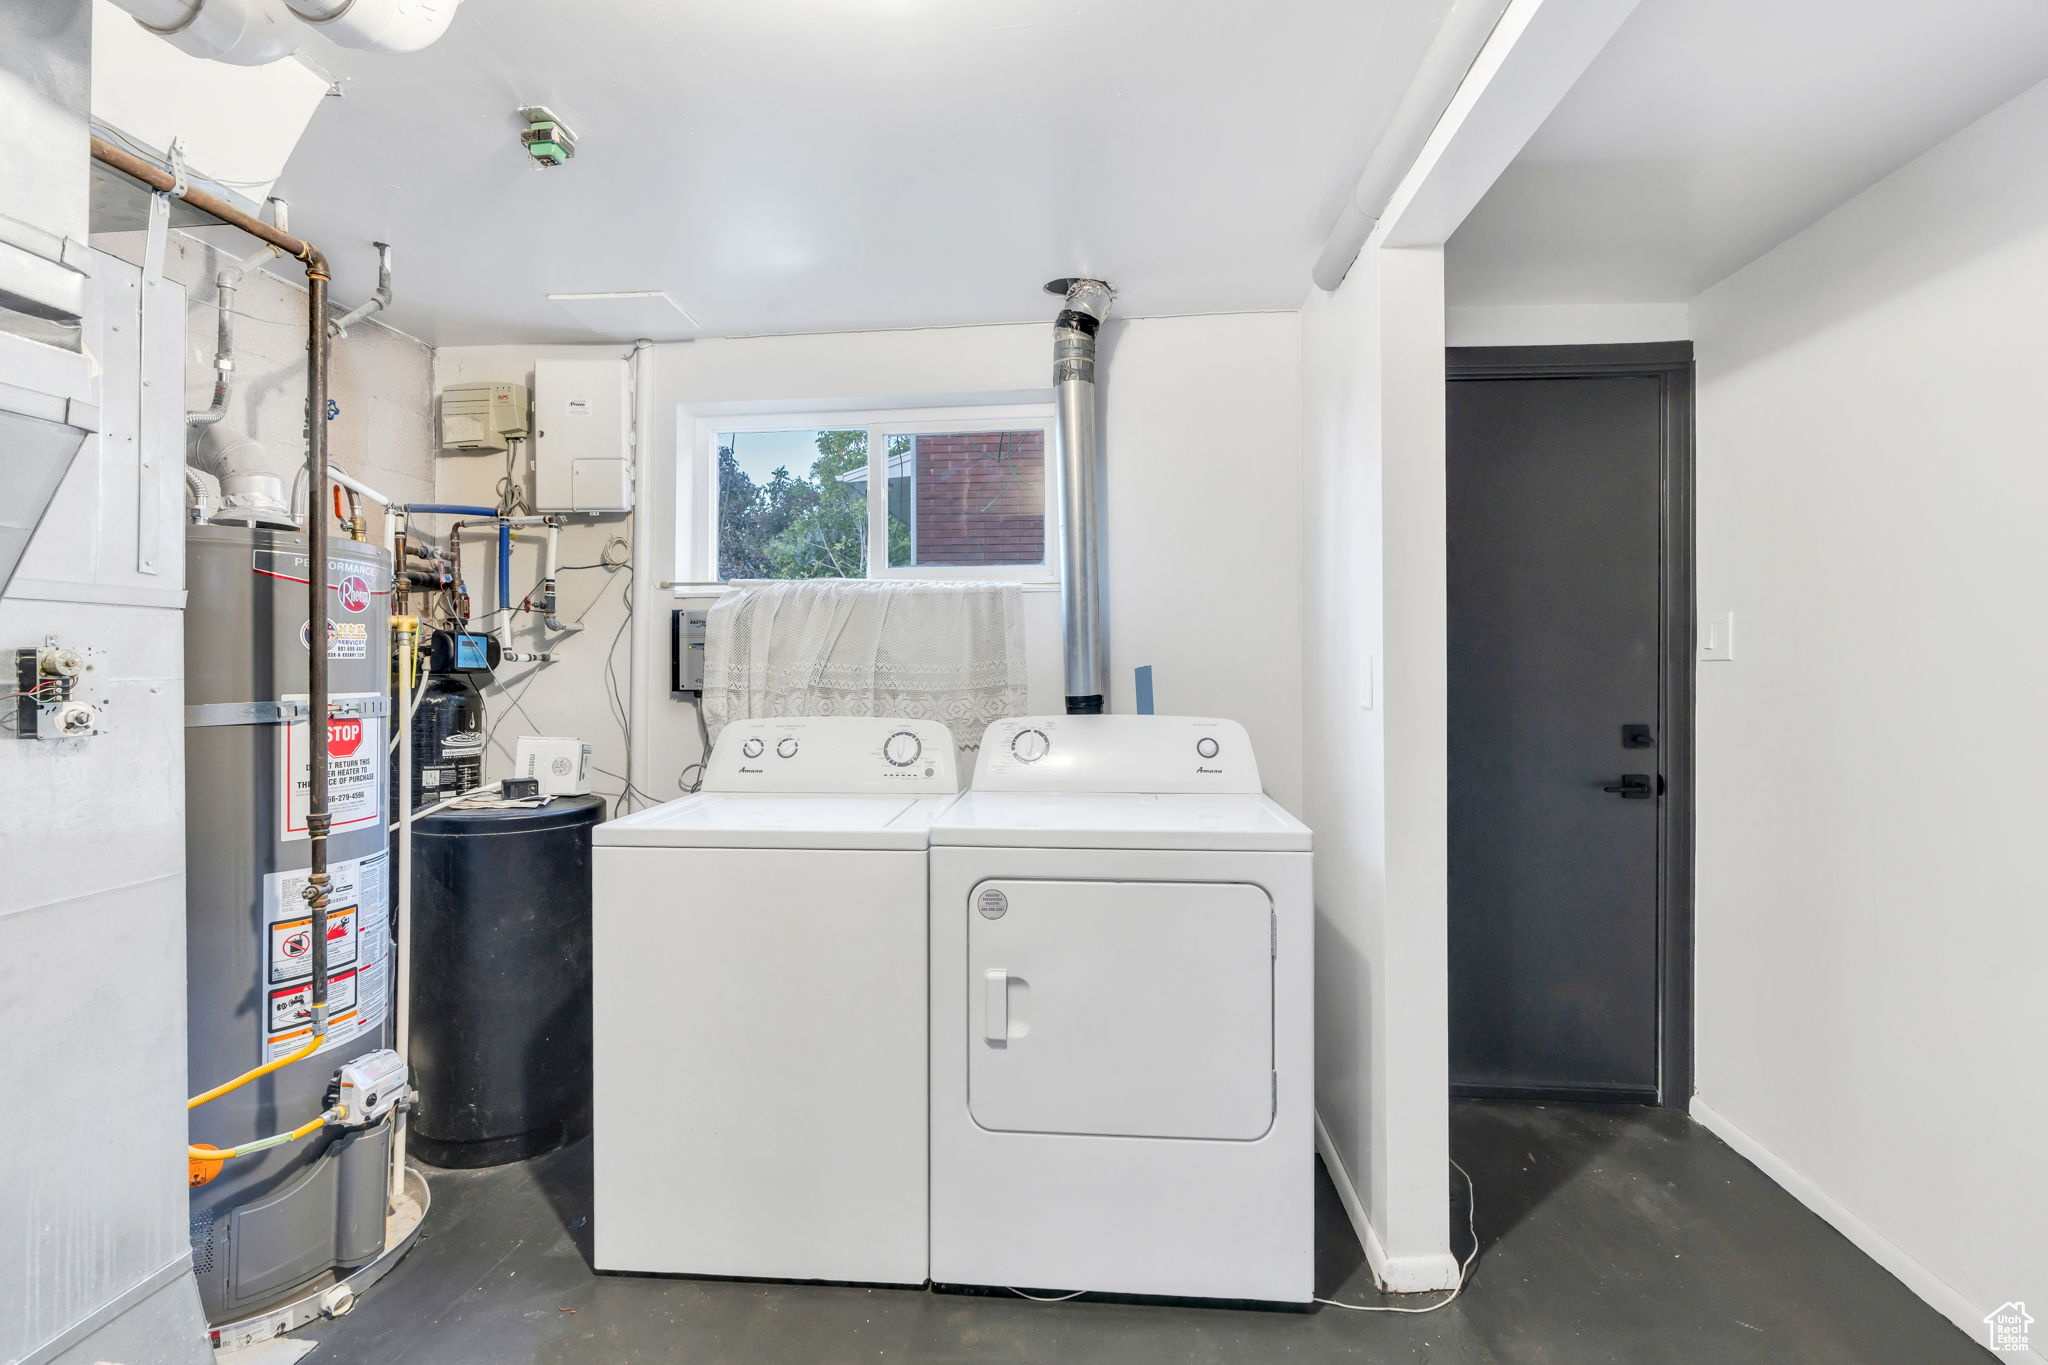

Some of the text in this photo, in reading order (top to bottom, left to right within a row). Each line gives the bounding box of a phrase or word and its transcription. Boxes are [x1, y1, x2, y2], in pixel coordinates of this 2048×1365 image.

[294, 557, 377, 577] PEORMANCE
[342, 575, 369, 607] Rheem
[328, 725, 360, 742] STOP
[334, 760, 358, 769] RETURN
[359, 758, 370, 766] THIS
[738, 766, 763, 774] Amana
[1196, 766, 1223, 774] Amana
[337, 767, 360, 776] HEATER
[297, 781, 310, 789] TH
[340, 777, 347, 785] OF
[349, 773, 374, 783] PURCHASE
